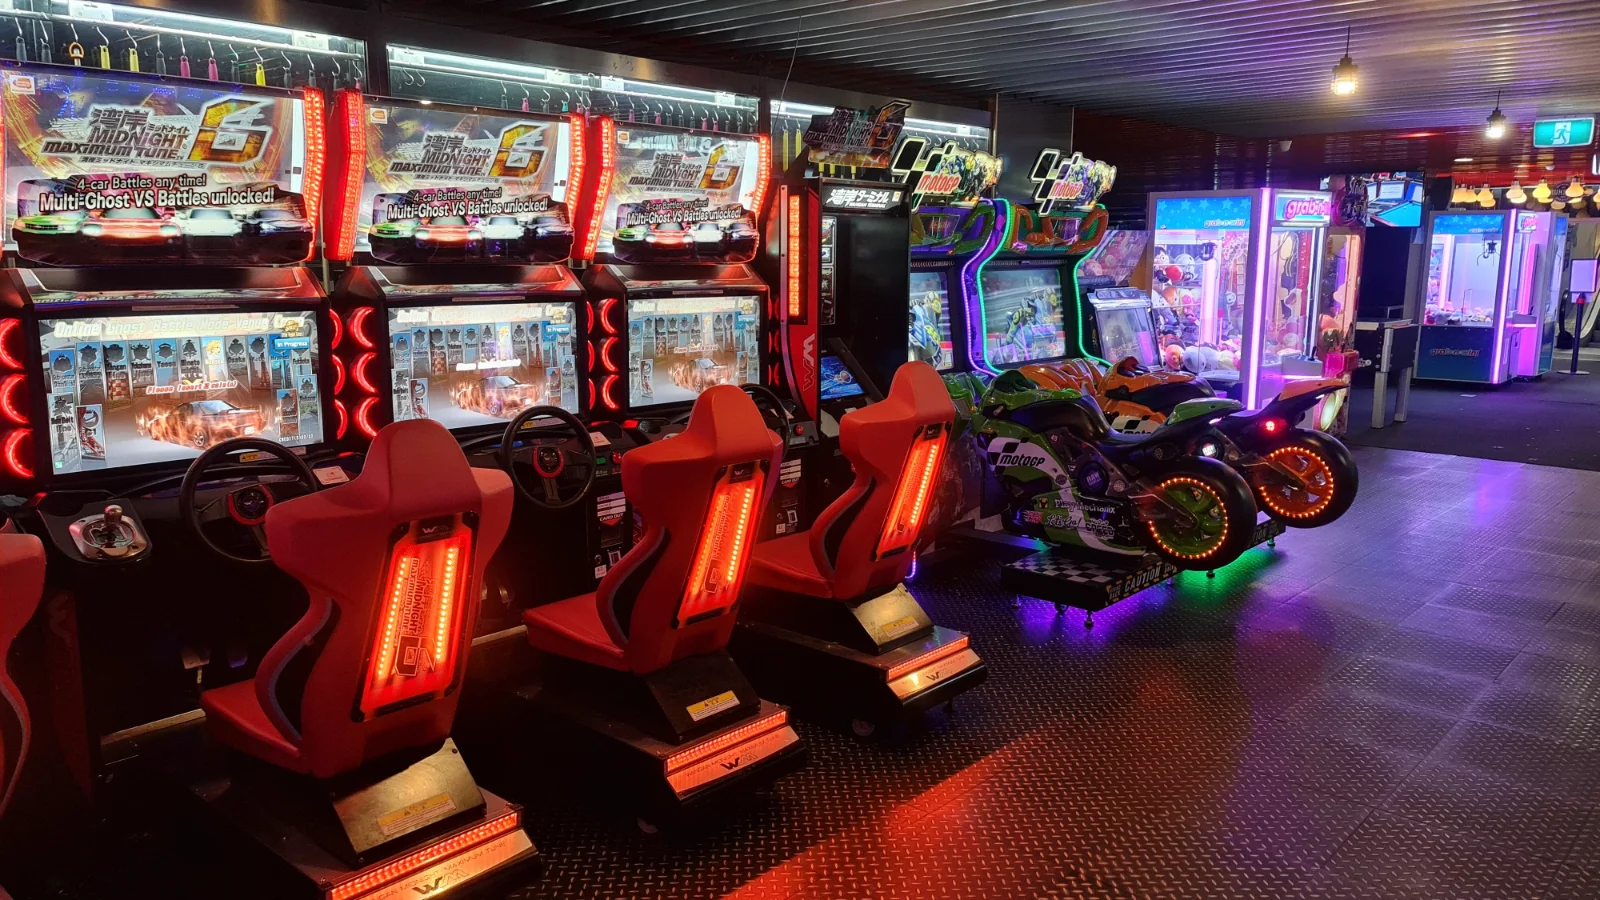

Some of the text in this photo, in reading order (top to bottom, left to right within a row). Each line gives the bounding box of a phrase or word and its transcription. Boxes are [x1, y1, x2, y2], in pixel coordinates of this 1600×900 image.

[88, 127, 188, 149] MIDNIGHT
[422, 151, 490, 167] MIDNIGHT
[652, 166, 701, 181] MIDNIGHT
[77, 174, 207, 191] 4-car Battles any time!
[39, 187, 275, 212] Multi-Ghost VS Battles unlocked!
[413, 187, 502, 202] 4-car Battles any time!
[387, 197, 548, 220] Multi-Ghost VS Battles unlocked!
[662, 199, 682, 210] Battles
[683, 200, 693, 209] any
[627, 208, 741, 225] Multi-Ghost VS Battles unlocked!
[153, 318, 193, 332] Battle
[236, 317, 269, 330] Venue
[284, 339, 308, 348] Progress
[1125, 565, 1161, 592] CAUTION
